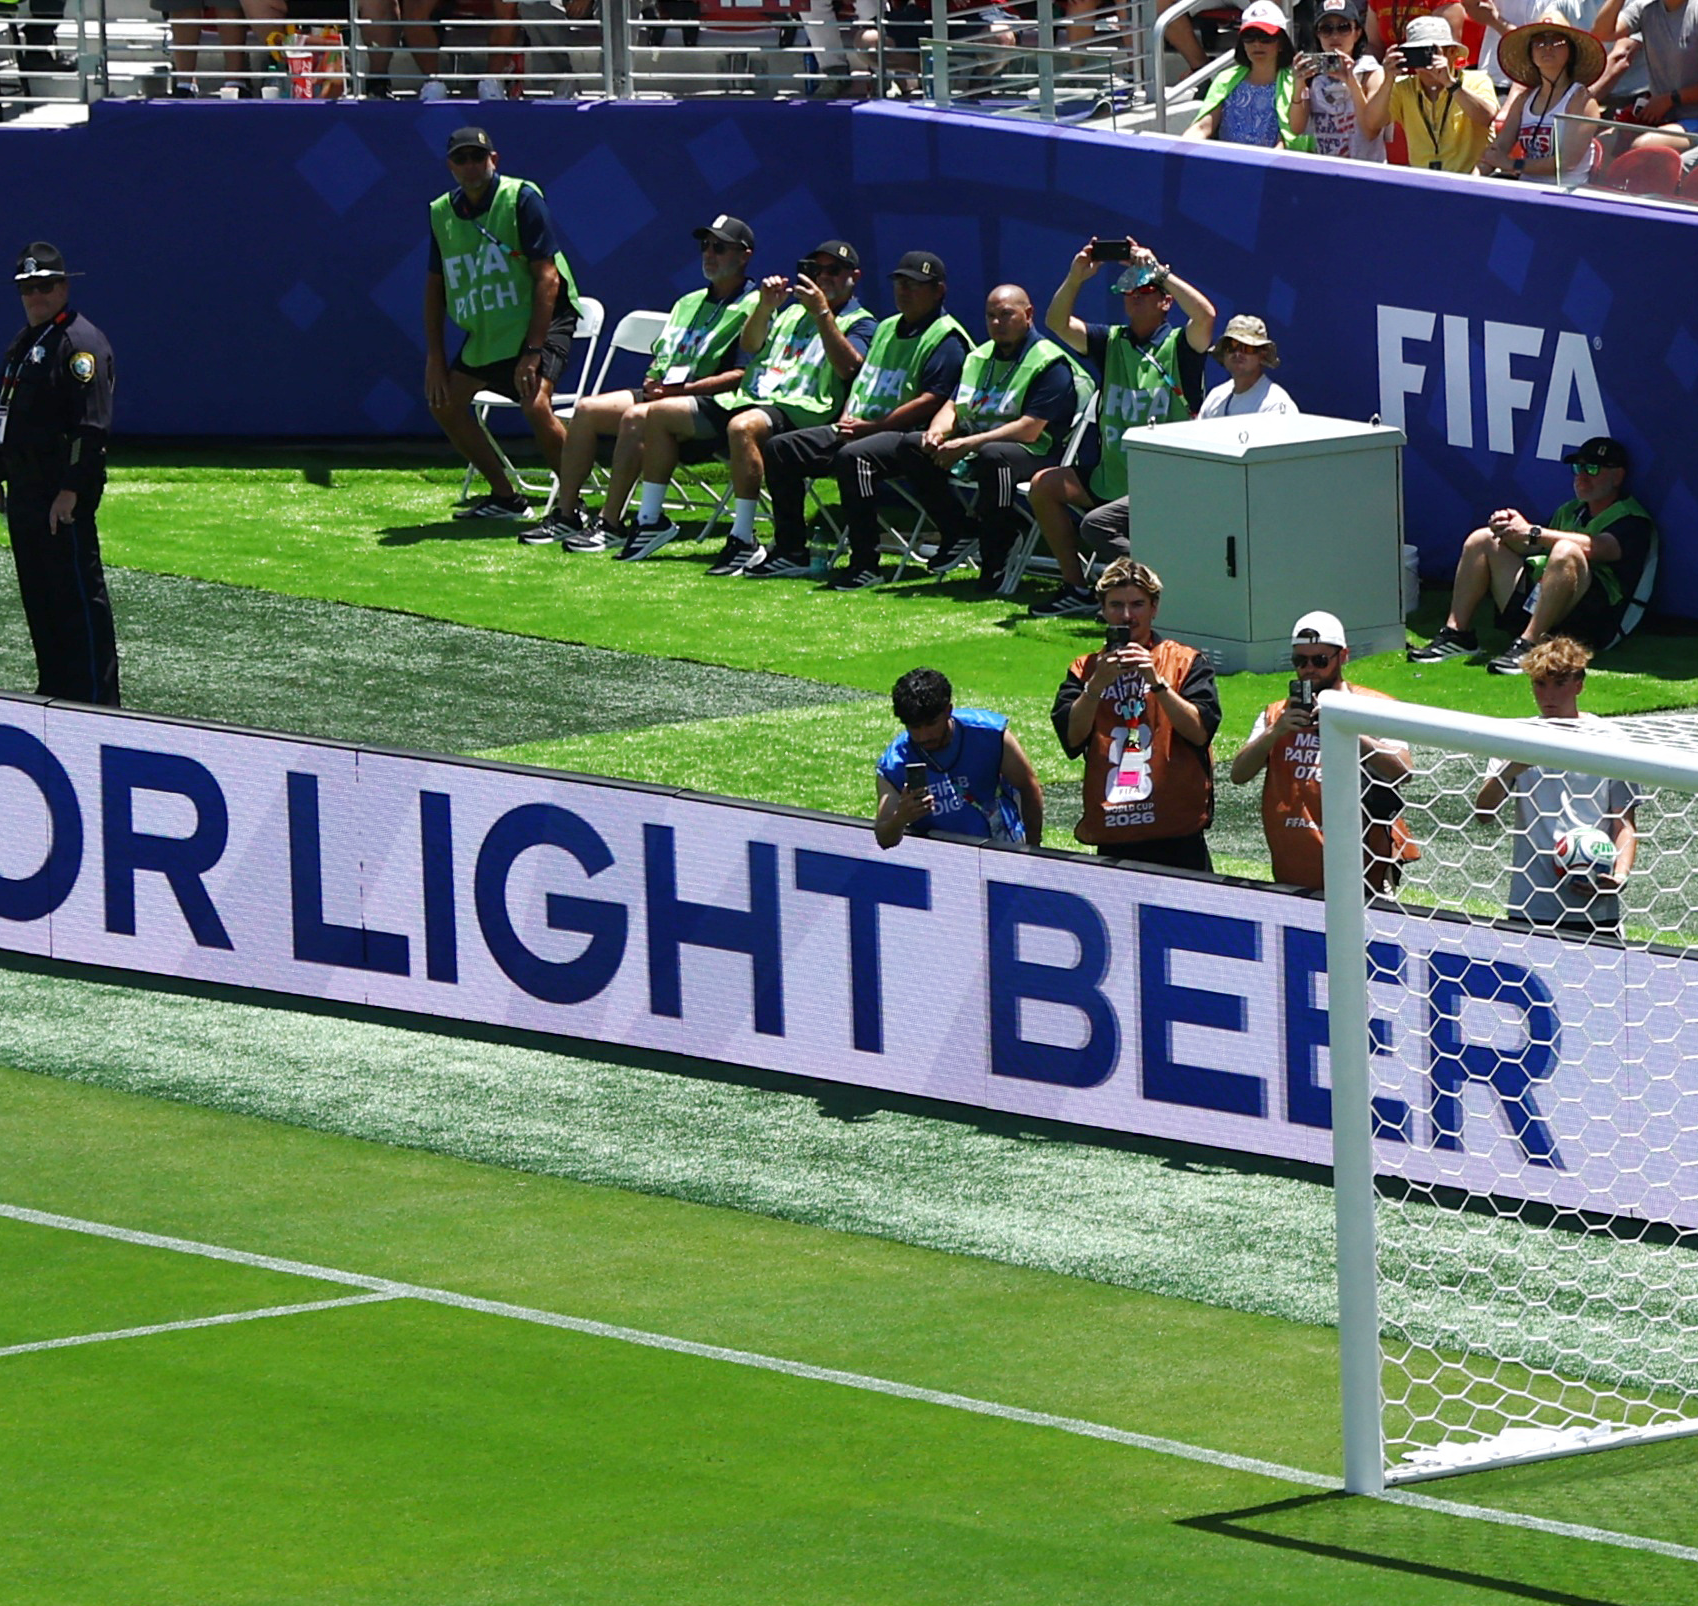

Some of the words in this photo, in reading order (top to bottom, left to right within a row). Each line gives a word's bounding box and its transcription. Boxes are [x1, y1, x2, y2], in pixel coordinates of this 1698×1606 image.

[444, 242, 510, 290] FIA
[1376, 304, 1611, 462] FIFA
[1104, 811, 1156, 828] 2026
[1136, 802, 1155, 811] CUP
[286, 771, 932, 1055] LIGHT
[984, 880, 1566, 1172] BEER
